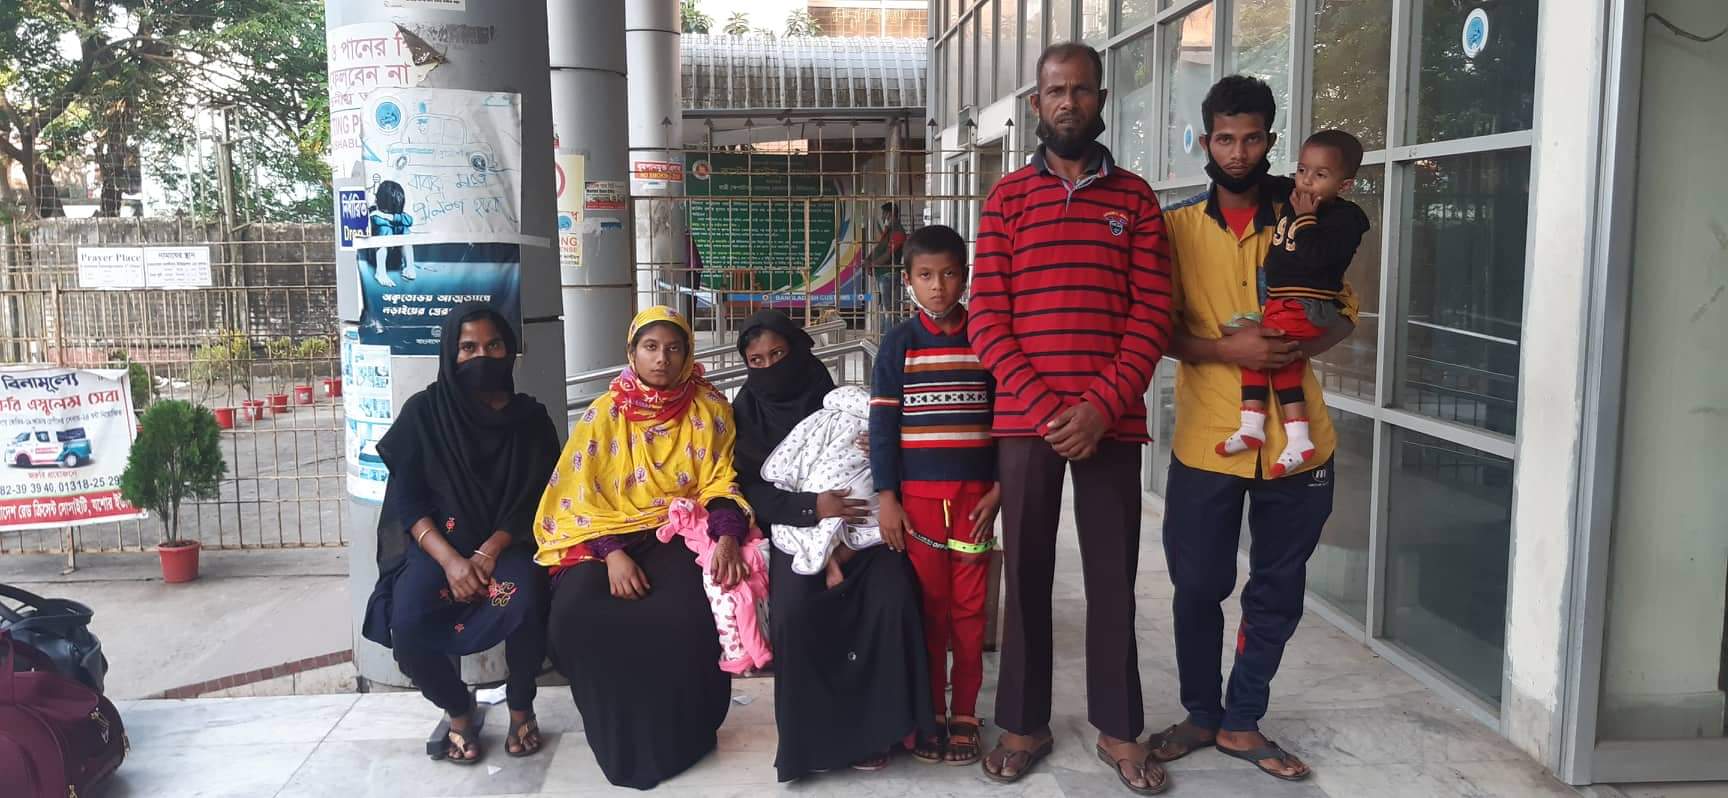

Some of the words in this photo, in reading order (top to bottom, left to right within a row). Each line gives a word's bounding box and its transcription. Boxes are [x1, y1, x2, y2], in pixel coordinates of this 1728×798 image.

[341, 37, 388, 60] পানের
[384, 61, 412, 85] না
[81, 253, 112, 265] Prayer
[116, 253, 141, 262] Place
[1, 372, 79, 392] বিনামূল্যে
[88, 389, 119, 405] সেবা
